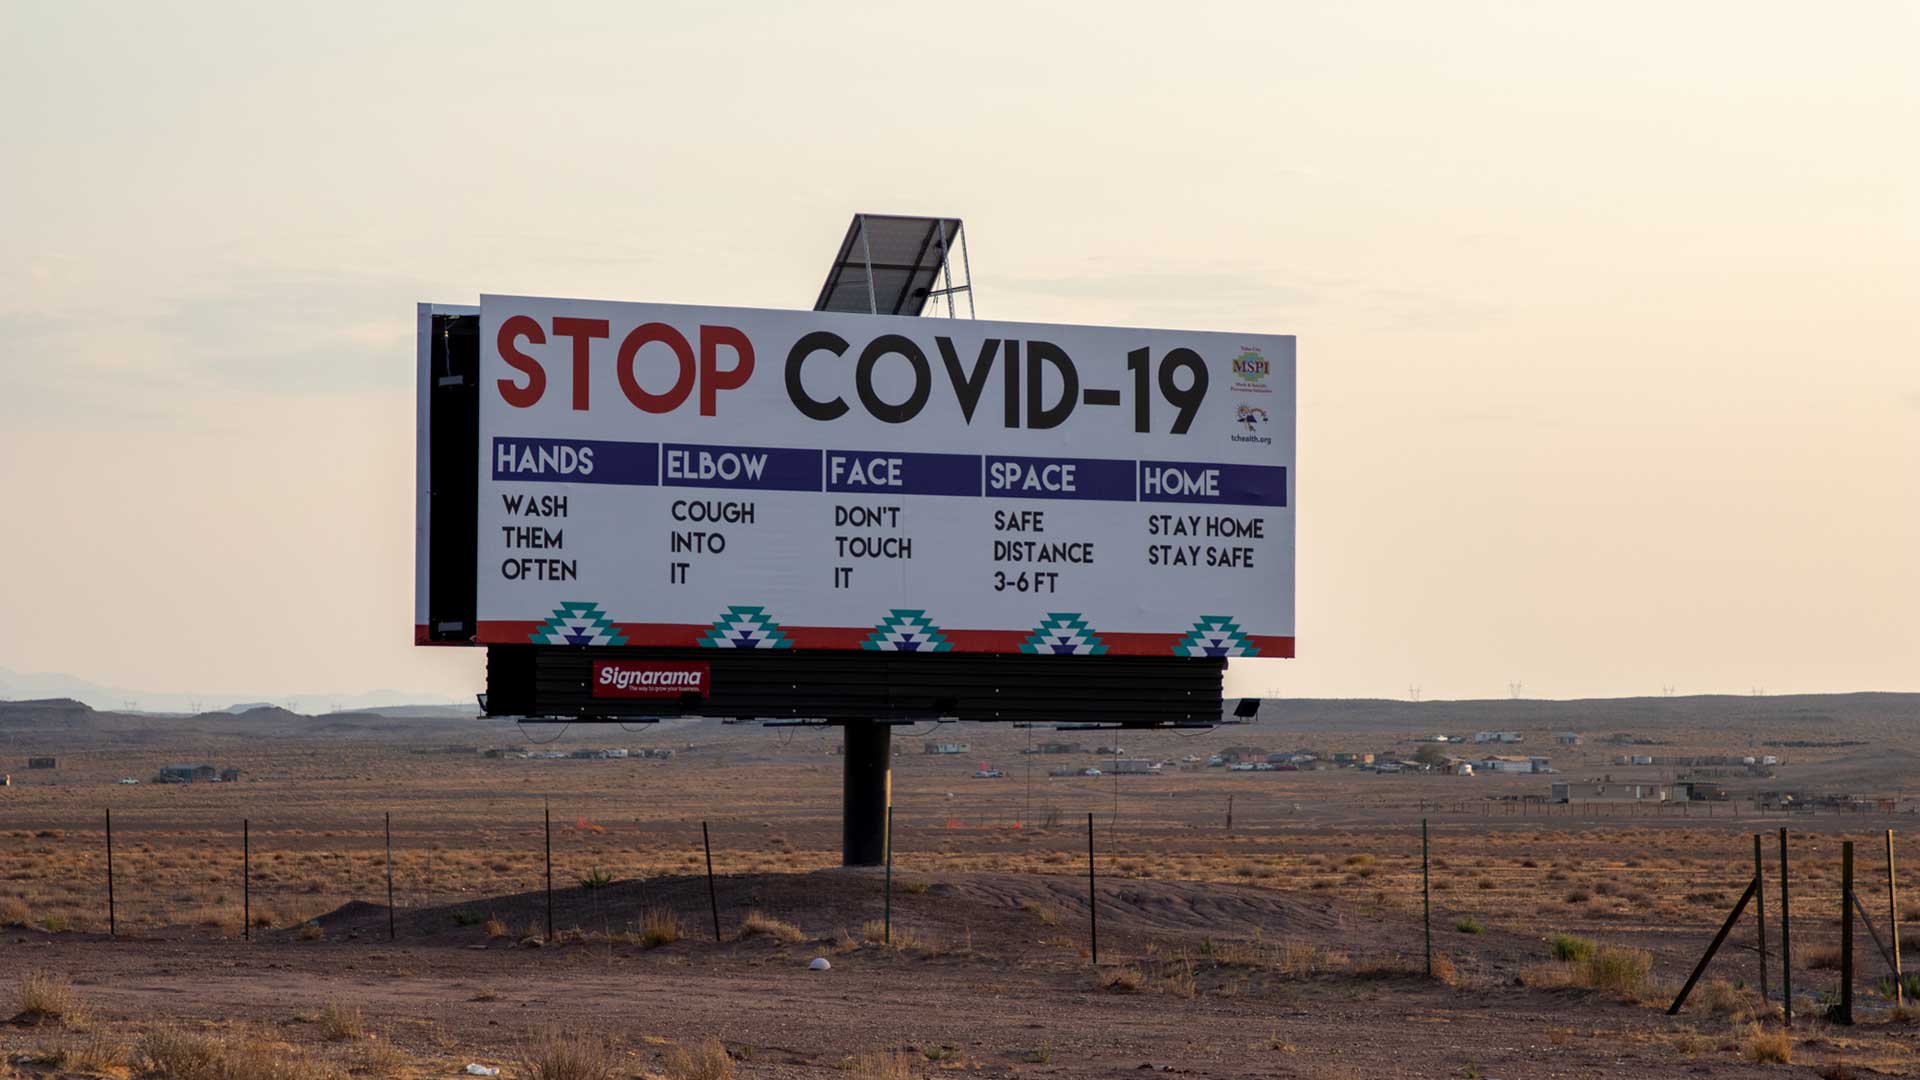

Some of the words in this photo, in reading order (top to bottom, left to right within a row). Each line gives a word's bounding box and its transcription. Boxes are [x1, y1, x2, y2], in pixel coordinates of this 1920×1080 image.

[497, 315, 755, 417] STOP
[784, 331, 1209, 435] COVID-19
[1232, 359, 1269, 375] MSPI
[1231, 434, 1272, 445] tchealth.org
[497, 444, 594, 475] HANDS
[667, 450, 768, 480] ELBOW
[830, 456, 903, 486] FACE
[990, 462, 1076, 492] SPACE
[1145, 467, 1220, 496] HOME
[501, 494, 568, 518] WASH
[671, 500, 755, 524] COUGH
[835, 505, 901, 529] DON'T
[994, 510, 1044, 532] SAFE
[1149, 515, 1202, 537] STAY
[1206, 516, 1264, 540] HOME
[502, 525, 564, 550] THEM
[671, 531, 726, 555] INTO
[835, 536, 912, 560] TOUCH
[994, 540, 1095, 564] DISTANCE
[1149, 545, 1202, 567] STAY
[1206, 546, 1255, 569] SAFE
[501, 558, 578, 582] OFTEN
[671, 562, 691, 585] IT
[835, 567, 854, 589] IT
[994, 571, 1030, 593] 3-6
[1034, 572, 1059, 594] FT
[599, 666, 702, 689] Signarama
